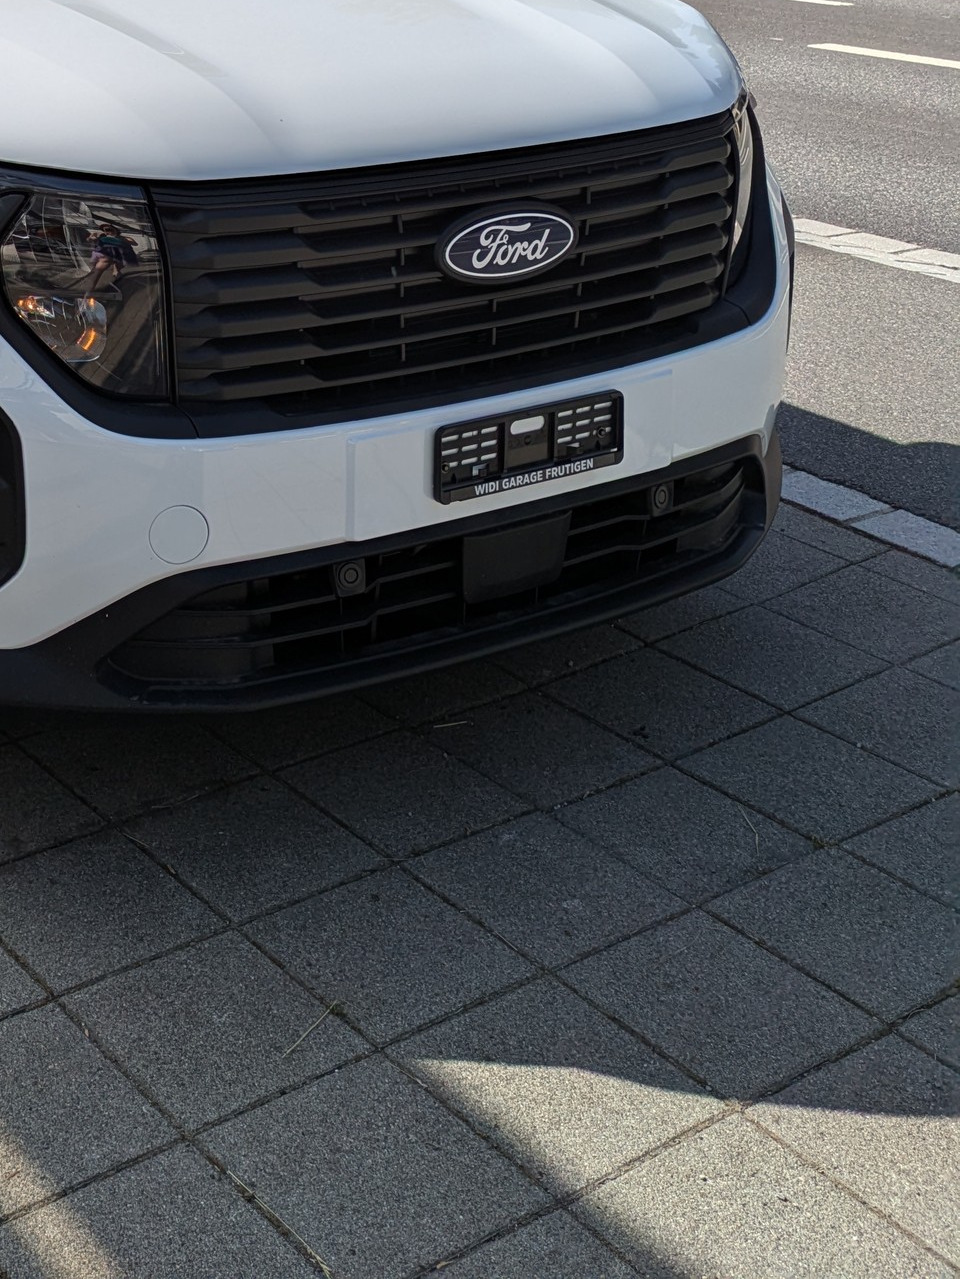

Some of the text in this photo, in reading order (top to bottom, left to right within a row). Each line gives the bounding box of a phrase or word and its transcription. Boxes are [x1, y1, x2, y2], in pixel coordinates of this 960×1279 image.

[472, 222, 551, 269] Ford
[474, 458, 594, 496] WIDI GARAGE FRUTIGEN
